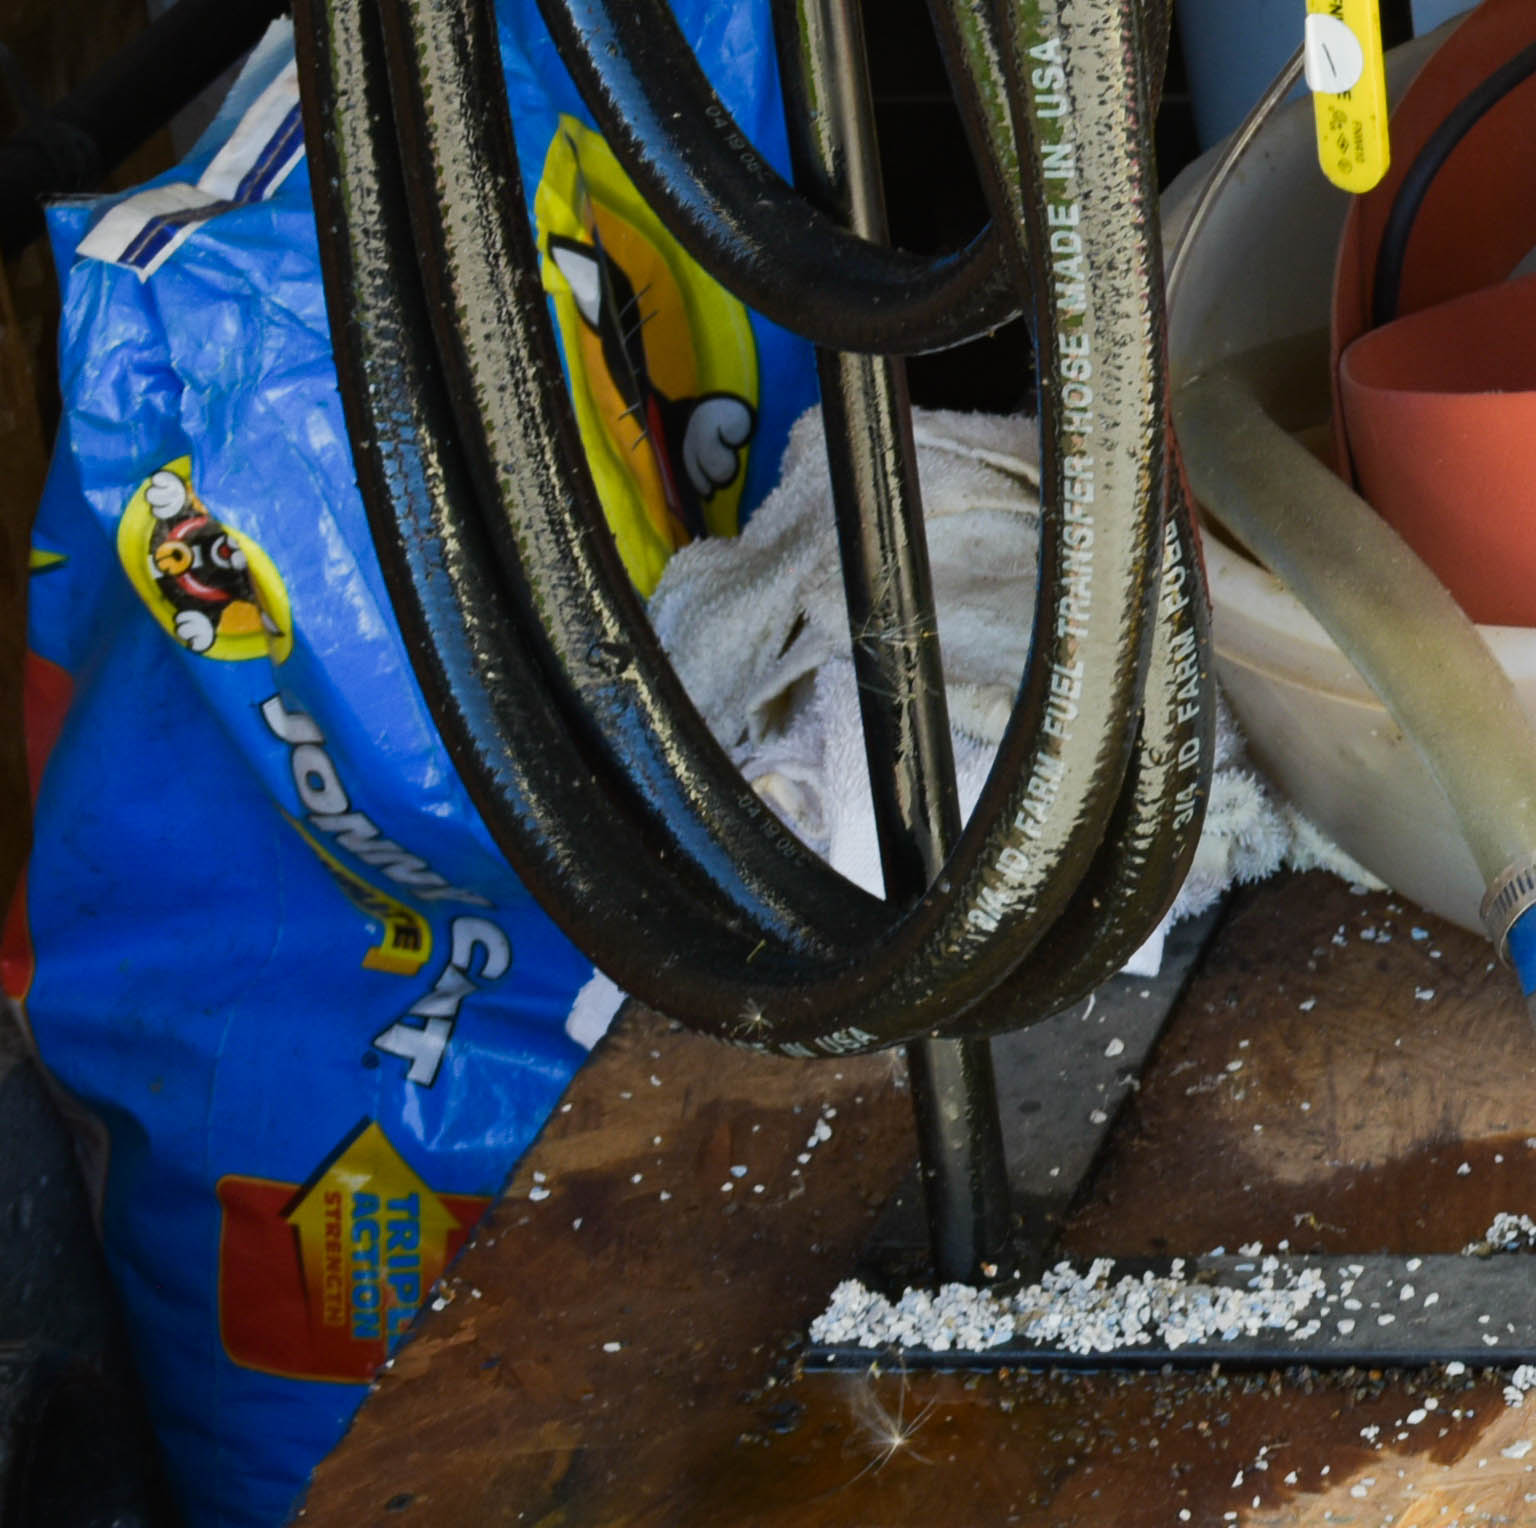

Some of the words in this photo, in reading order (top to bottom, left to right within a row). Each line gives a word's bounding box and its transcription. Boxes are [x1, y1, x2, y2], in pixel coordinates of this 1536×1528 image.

[1028, 37, 1069, 119] USA
[1320, 42, 1339, 78] 1
[1040, 144, 1076, 180] IN
[1047, 202, 1087, 313] MADE
[1058, 331, 1095, 437] HOSE
[1057, 446, 1097, 640] TRANSFER
[1042, 659, 1086, 743] FUEL
[1176, 624, 1202, 725] FARM
[1012, 752, 1067, 841] FARM
[1176, 736, 1202, 771] ID
[261, 693, 496, 909] JONNY
[1171, 781, 1198, 834] 3/4
[966, 882, 1004, 935] 3/4
[995, 846, 1031, 890] ID
[373, 915, 513, 1090] CAT
[324, 1190, 343, 1327] STRENGTH
[351, 1191, 381, 1339] ACTION
